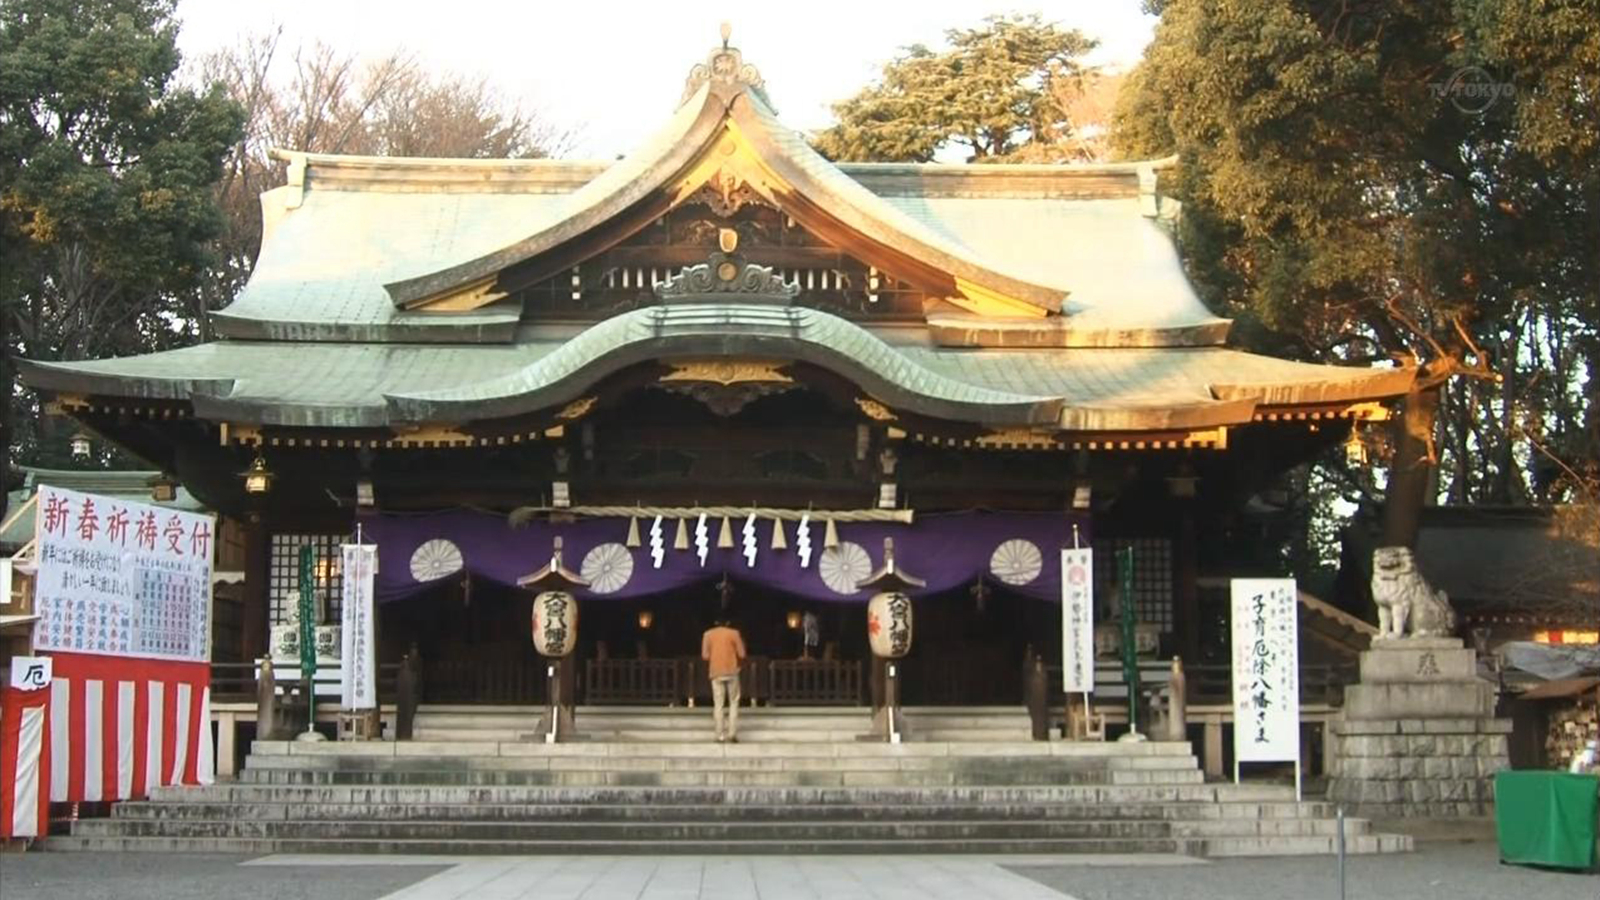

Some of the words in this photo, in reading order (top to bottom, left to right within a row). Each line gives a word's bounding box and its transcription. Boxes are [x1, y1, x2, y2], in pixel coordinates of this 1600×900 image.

[44, 492, 211, 560] 新春祈祷受付
[23, 665, 46, 686] 厄
[1251, 594, 1272, 743] 子育厄除八幡さま
